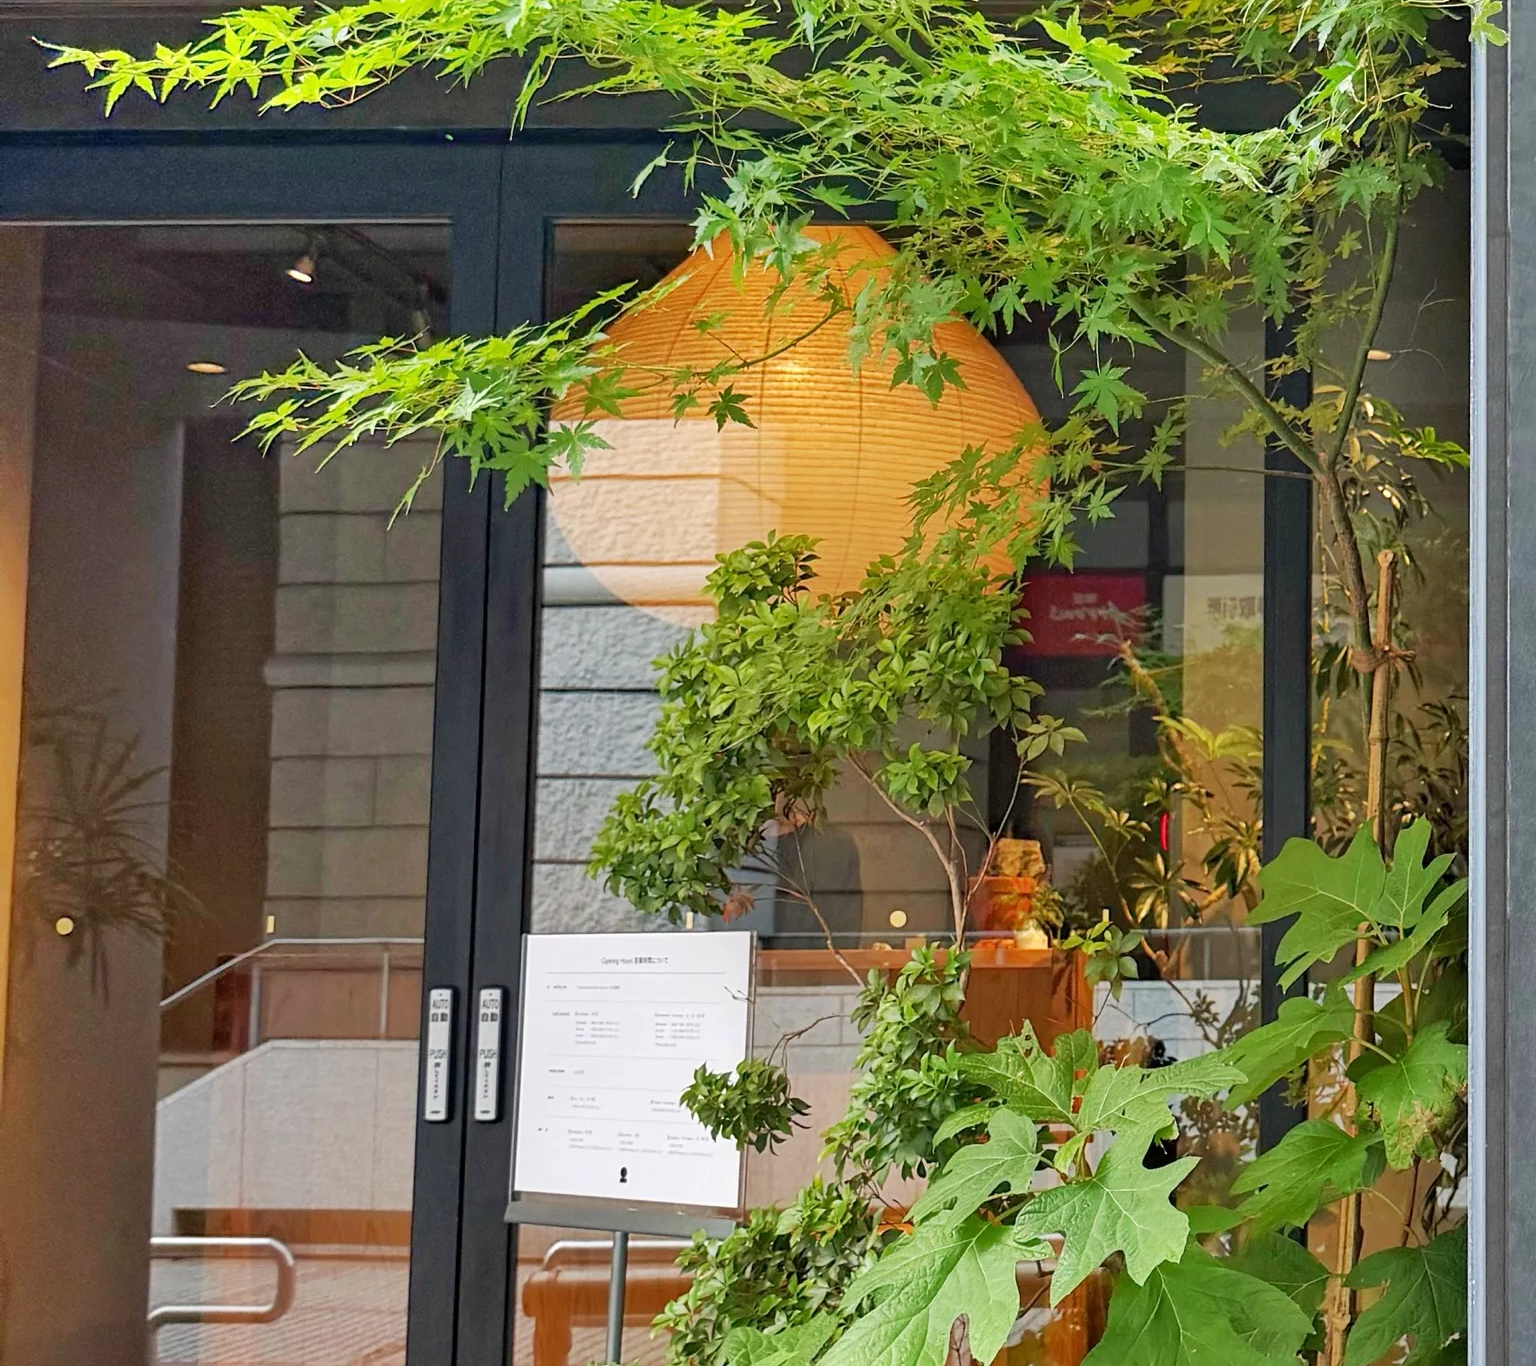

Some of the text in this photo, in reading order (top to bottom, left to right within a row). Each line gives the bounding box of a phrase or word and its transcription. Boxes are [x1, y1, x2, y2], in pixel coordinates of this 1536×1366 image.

[432, 999, 449, 1009] AUTO
[482, 999, 499, 1009] AUTO
[431, 1013, 448, 1022] 自動
[481, 1013, 498, 1022] 自動
[429, 1049, 447, 1059] PUSH
[479, 1049, 497, 1059] PUSH
